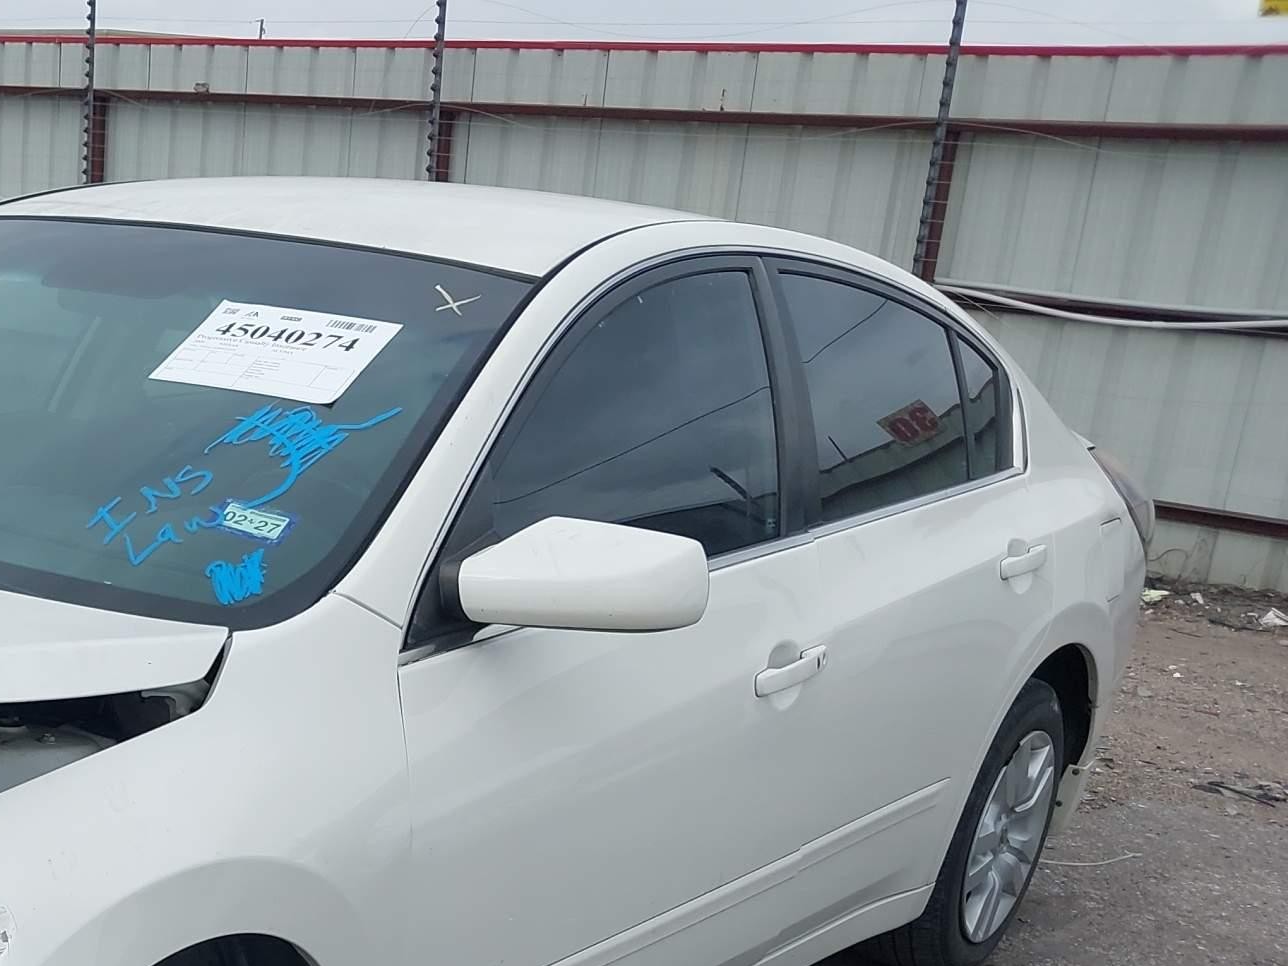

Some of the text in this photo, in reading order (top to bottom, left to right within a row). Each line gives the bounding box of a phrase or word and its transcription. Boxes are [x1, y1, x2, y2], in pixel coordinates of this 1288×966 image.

[216, 321, 360, 352] 45040274
[223, 510, 282, 535] 02 27
